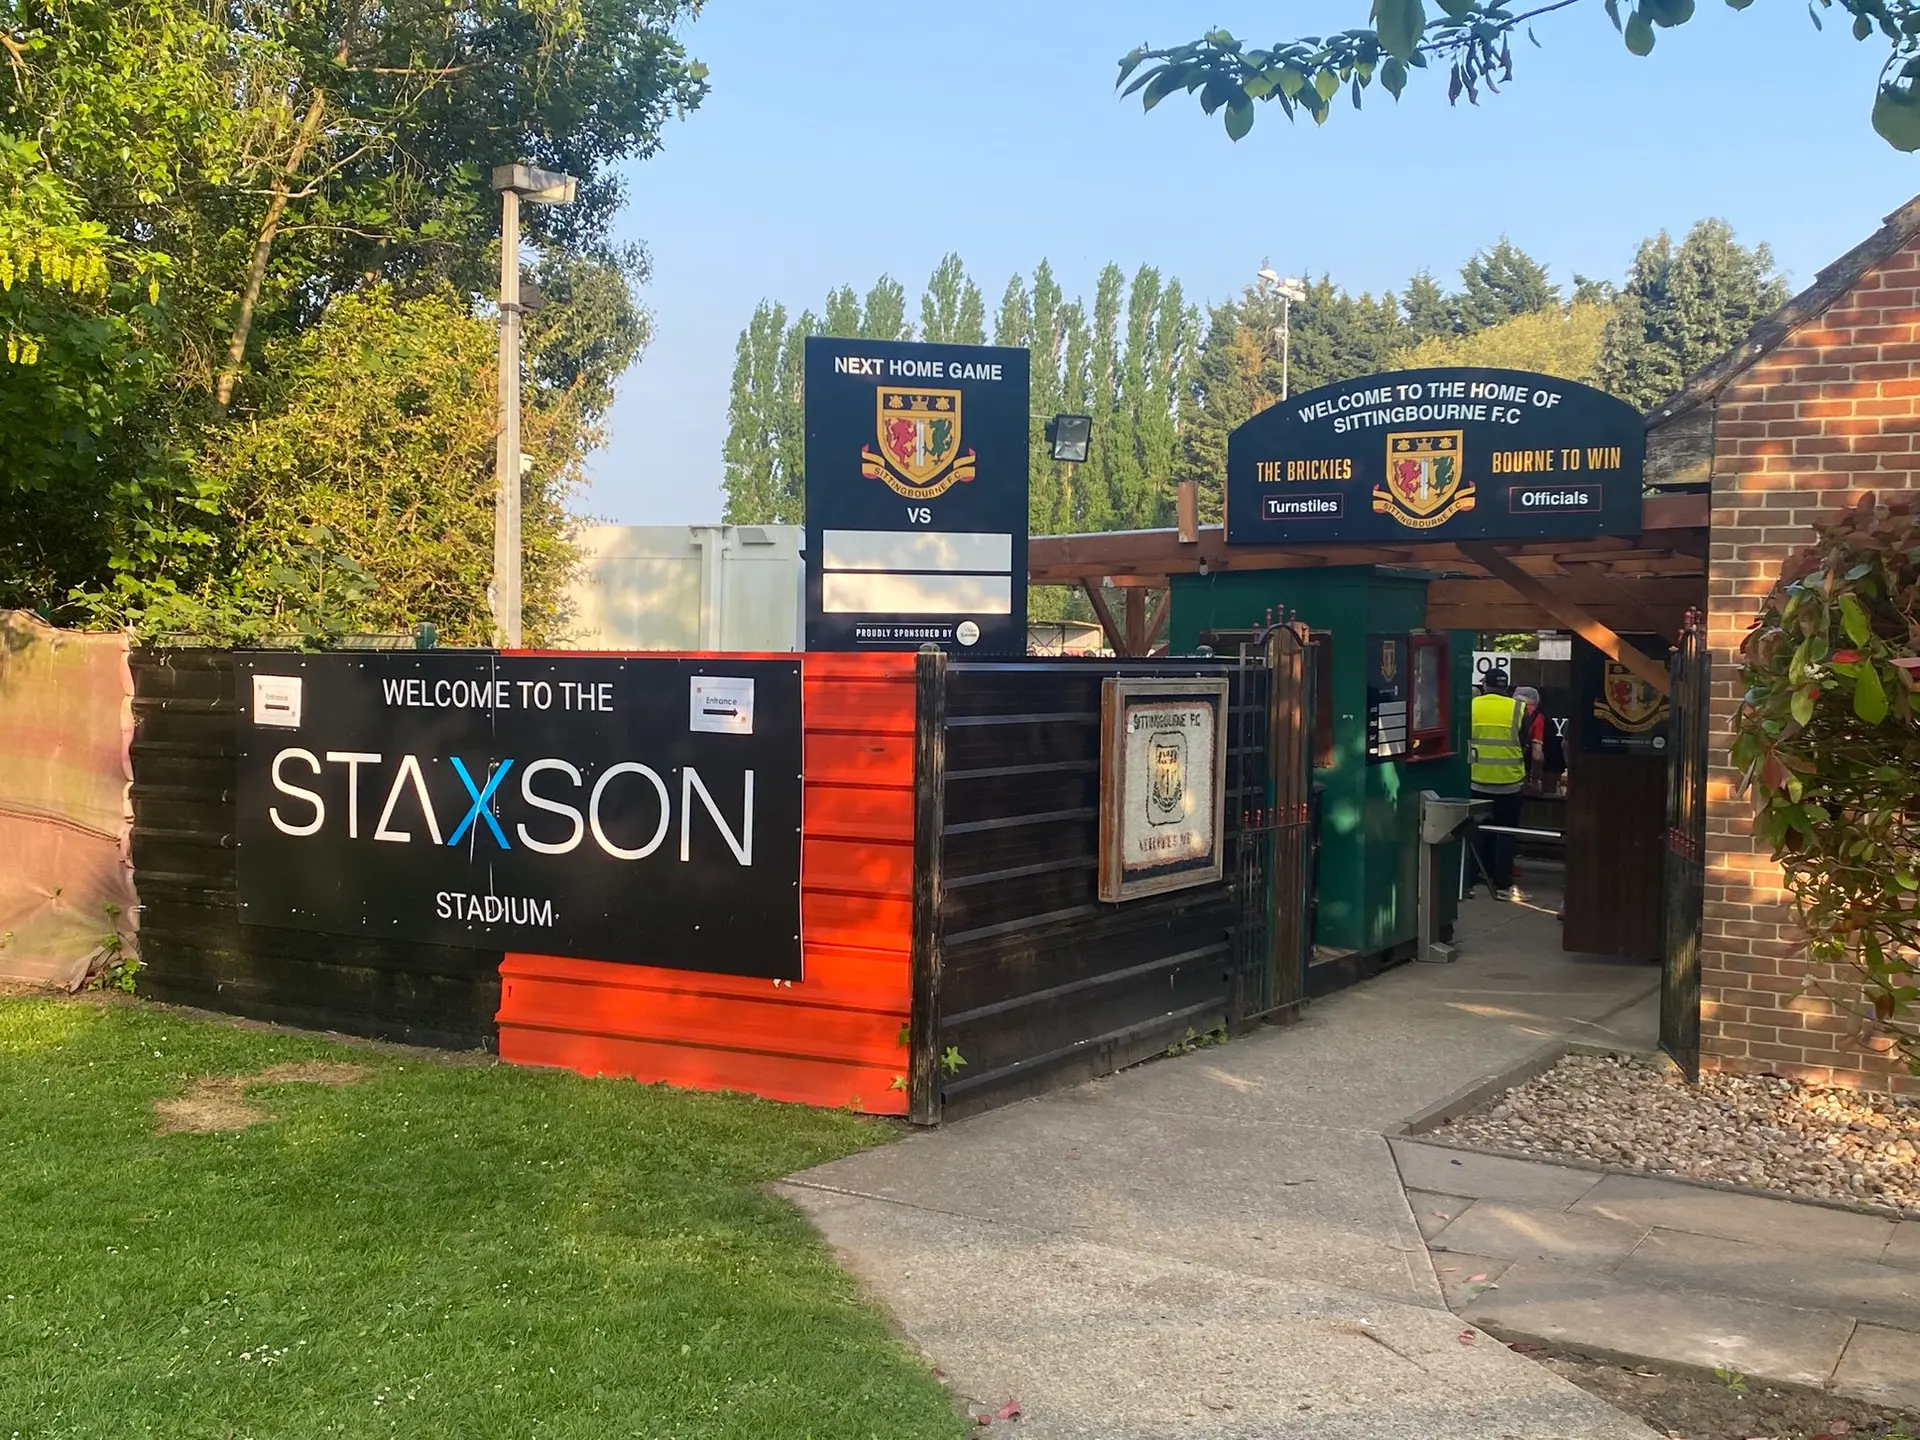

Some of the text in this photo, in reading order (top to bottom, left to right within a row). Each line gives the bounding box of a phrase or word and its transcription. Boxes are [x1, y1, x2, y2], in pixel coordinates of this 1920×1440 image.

[834, 356, 1003, 380] NEXT HOME GAME
[1298, 382, 1562, 423] WELCOME TO THE HOME OF
[1333, 405, 1486, 434] SITTINGBOURNE
[1256, 459, 1352, 482] THE BRICKIES
[1492, 447, 1621, 474] BOURNE TO WIN
[873, 467, 949, 498] SITTINGBOURNE
[1268, 499, 1338, 514] Turnstiles
[1522, 491, 1588, 506] Officials
[907, 507, 932, 525] VS
[1382, 502, 1449, 528] SITTINGBOURNE
[856, 628, 891, 637] PROUDLY
[894, 629, 940, 637] SPONSORED
[942, 629, 952, 637] BY
[382, 678, 614, 711] WELCOME TO THE
[706, 696, 738, 705] Entrance
[269, 747, 754, 866] STAXSON
[435, 891, 553, 927] STADIUM
